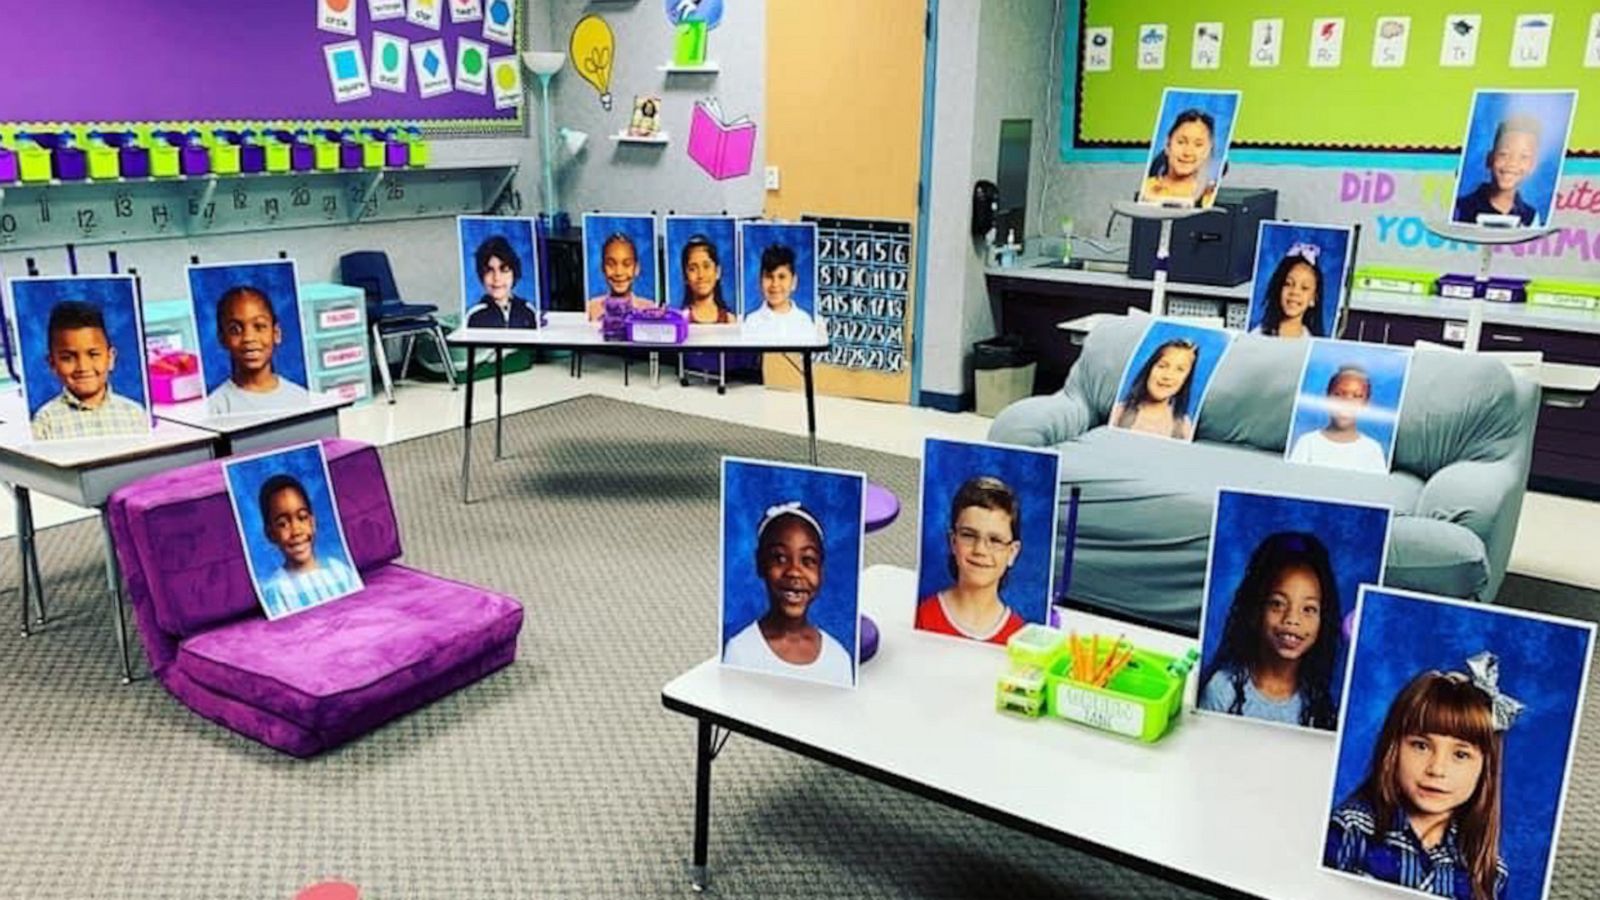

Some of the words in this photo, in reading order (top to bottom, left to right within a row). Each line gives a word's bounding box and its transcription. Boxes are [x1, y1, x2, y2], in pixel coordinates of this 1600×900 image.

[77, 209, 97, 229] 12
[820, 239, 832, 259] 2
[839, 240, 851, 260] 3
[855, 241, 868, 260] 4
[875, 242, 887, 261] 5
[894, 244, 906, 264] 6
[820, 265, 832, 285] 8
[837, 266, 849, 286] 9
[873, 270, 886, 289] 11
[890, 271, 906, 290] 12
